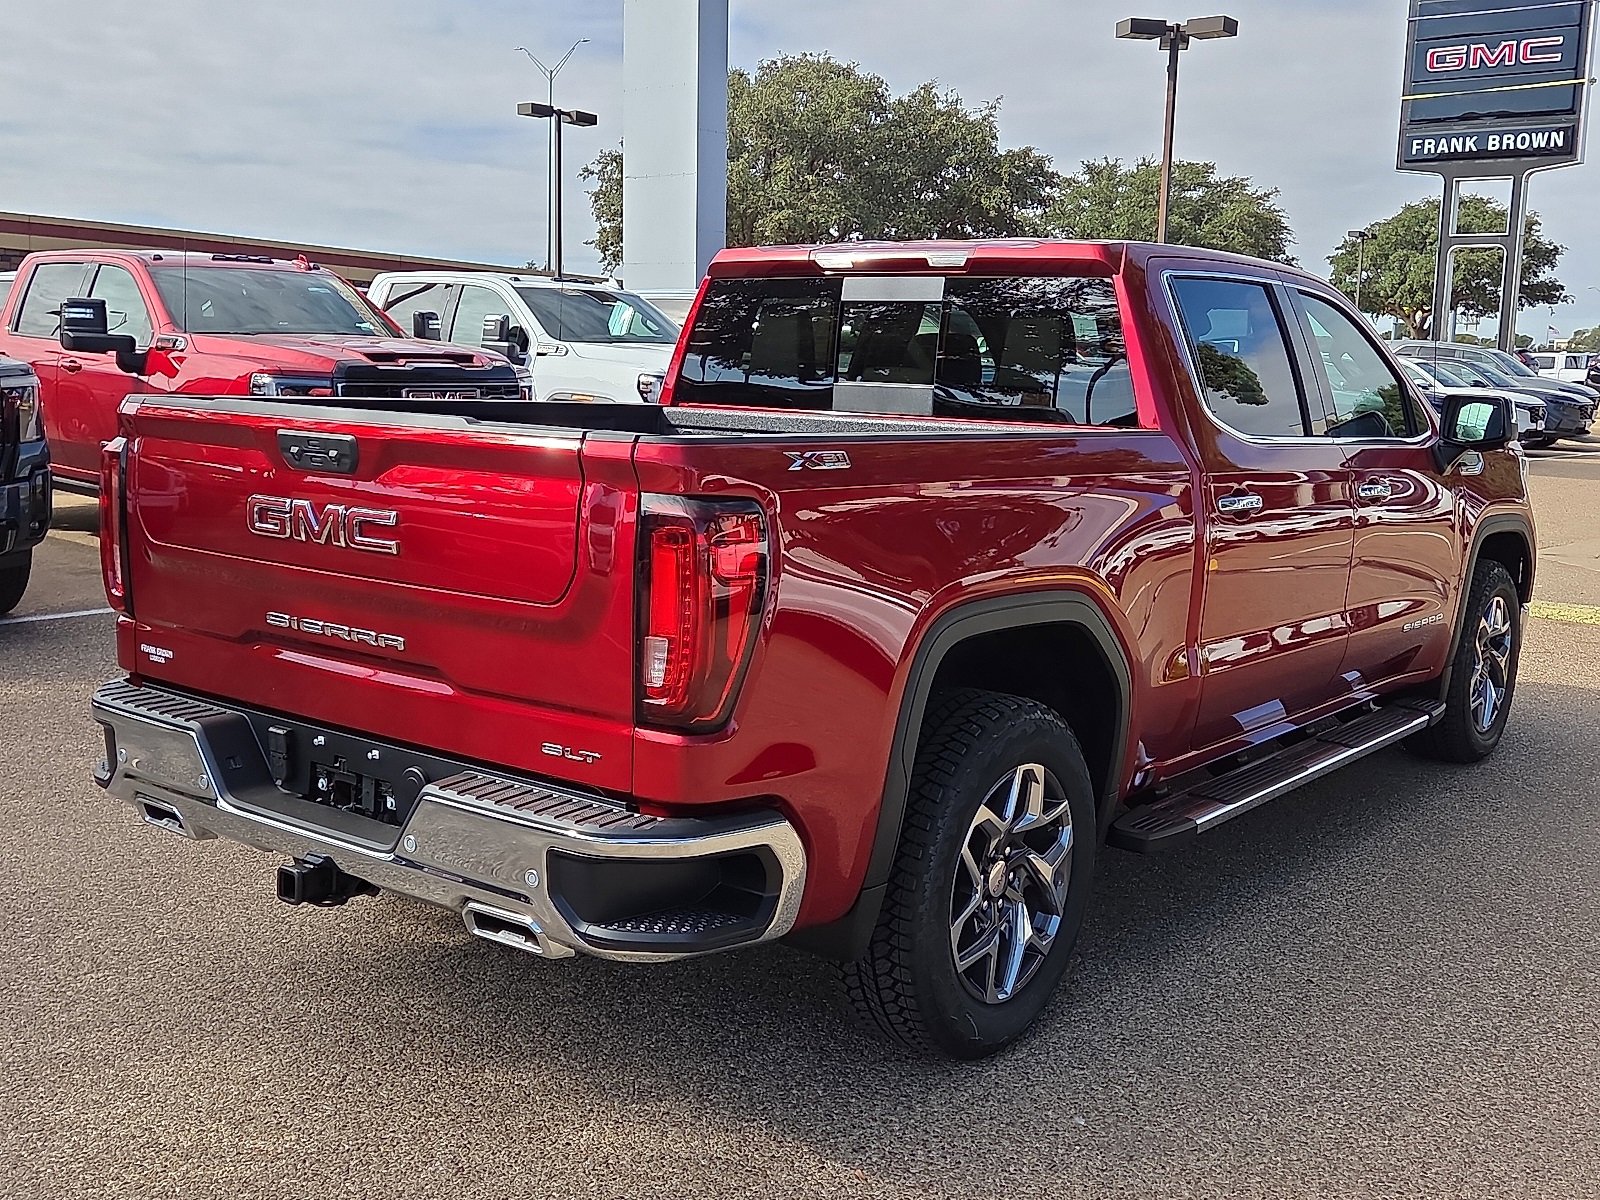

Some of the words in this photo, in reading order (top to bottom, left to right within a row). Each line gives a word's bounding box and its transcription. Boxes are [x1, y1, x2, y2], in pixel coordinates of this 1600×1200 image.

[1426, 36, 1563, 72] GMC
[1411, 136, 1478, 155] FRANK
[1487, 131, 1565, 151] BROWN
[247, 494, 398, 555] GMC
[266, 612, 405, 650] SIERRA
[541, 742, 602, 763] SLT
